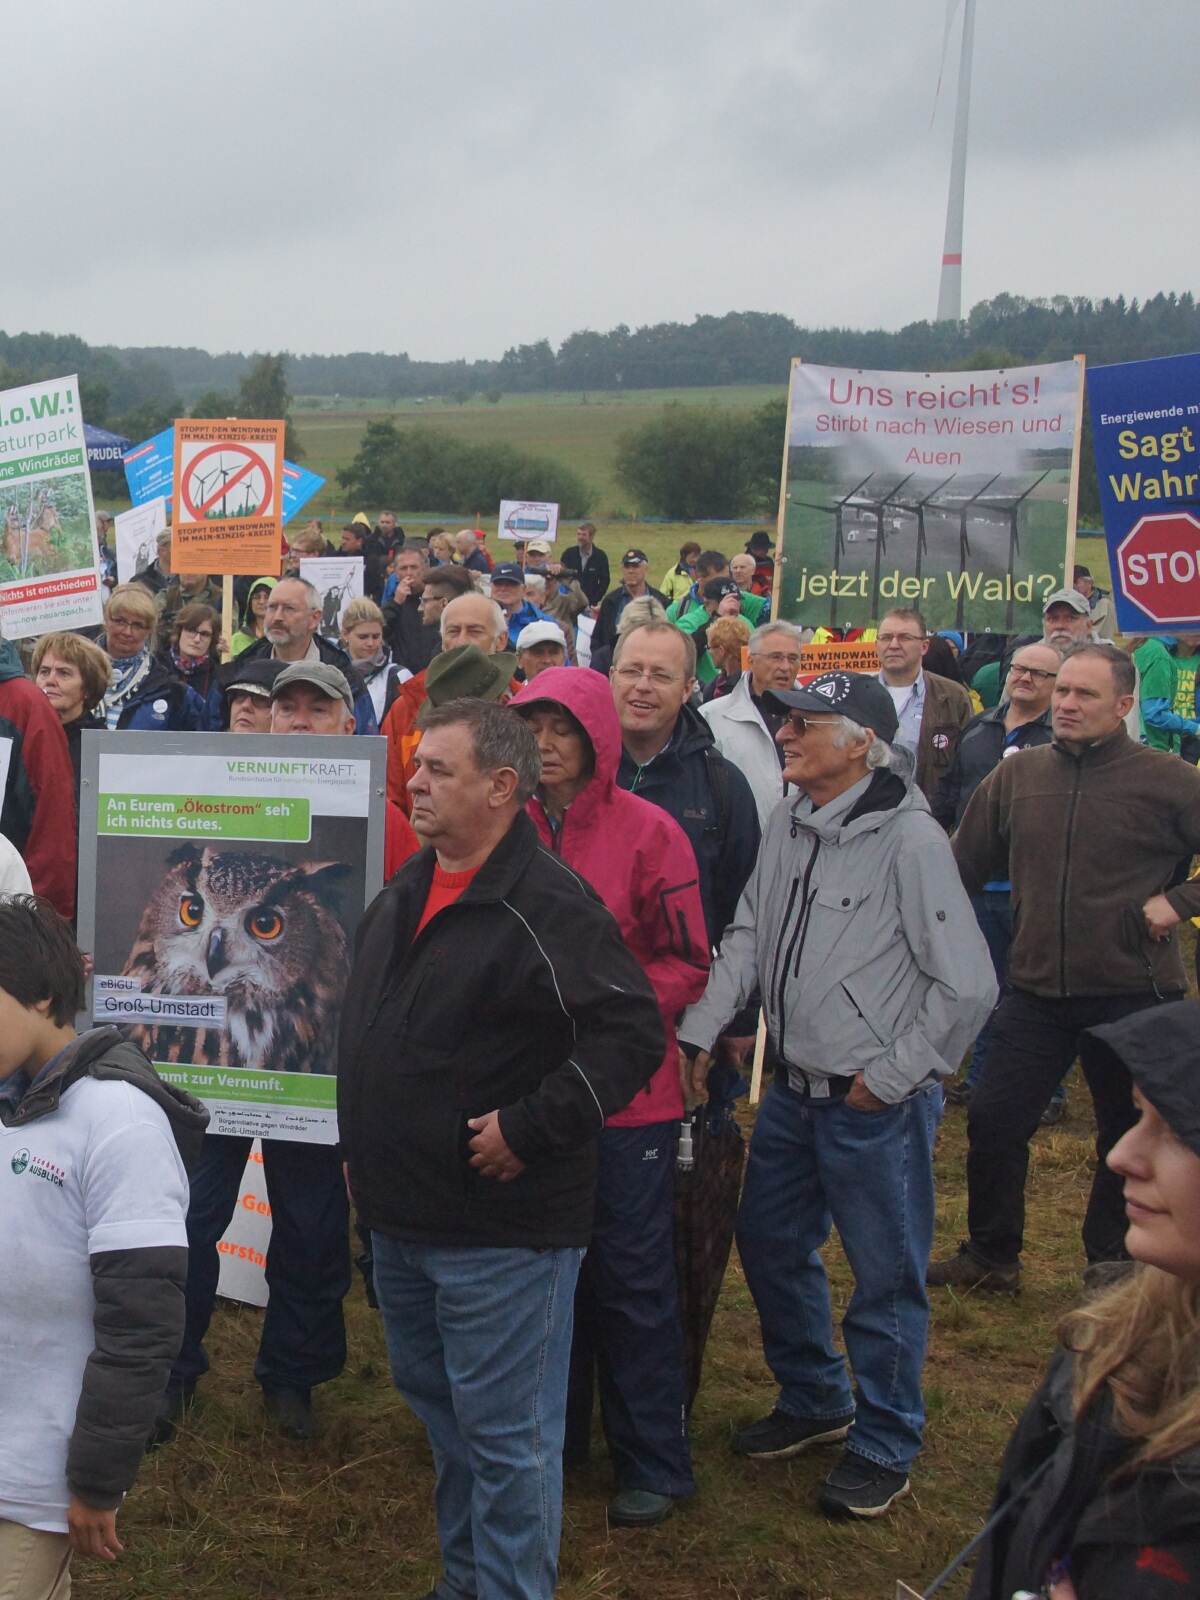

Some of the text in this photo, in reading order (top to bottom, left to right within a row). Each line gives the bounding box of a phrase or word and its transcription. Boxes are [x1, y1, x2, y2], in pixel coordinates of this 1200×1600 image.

[829, 377, 894, 407] Uns
[816, 414, 1062, 435] Stirbt nach Wiesen und
[1100, 406, 1184, 425] Energiewende
[193, 433, 277, 441] MAIN-KINZIG-KREIS!
[230, 426, 278, 434] WINDWAHN
[87, 446, 124, 461] PRUDEL
[1118, 426, 1196, 463] Sagt
[18, 451, 81, 473] Windräder
[905, 447, 961, 466] Auen
[178, 522, 276, 536] STOPPT DEN WINDWAHN
[191, 529, 275, 542] MAIN-KINZIG-KREIS!
[1127, 549, 1200, 586] STO
[0, 577, 96, 602] Nichts ist entschieden!
[796, 567, 1058, 603] jetzt der Wald?
[1, 604, 41, 617] Informieren
[44, 600, 55, 609] Sie
[56, 597, 71, 607] sich
[800, 652, 814, 661] EN
[800, 658, 882, 671] KINZIG-KREIS!
[226, 761, 357, 777] VERNUNFTKRAFT.
[107, 798, 127, 811] An
[130, 799, 175, 813] Eurem
[107, 815, 222, 831] ich nichts Gutes.
[100, 979, 133, 990] eBiGU
[104, 996, 216, 1017] Groß-Umstadt
[158, 1072, 285, 1091] mmt zur Vernunft.
[218, 1117, 260, 1127] Bürgerinitiative
[279, 1122, 308, 1131] Windräder
[218, 1125, 270, 1137] Groß-Umstadt
[28, 1164, 64, 1188] AUSBLICK
[217, 1239, 267, 1268] ersta
